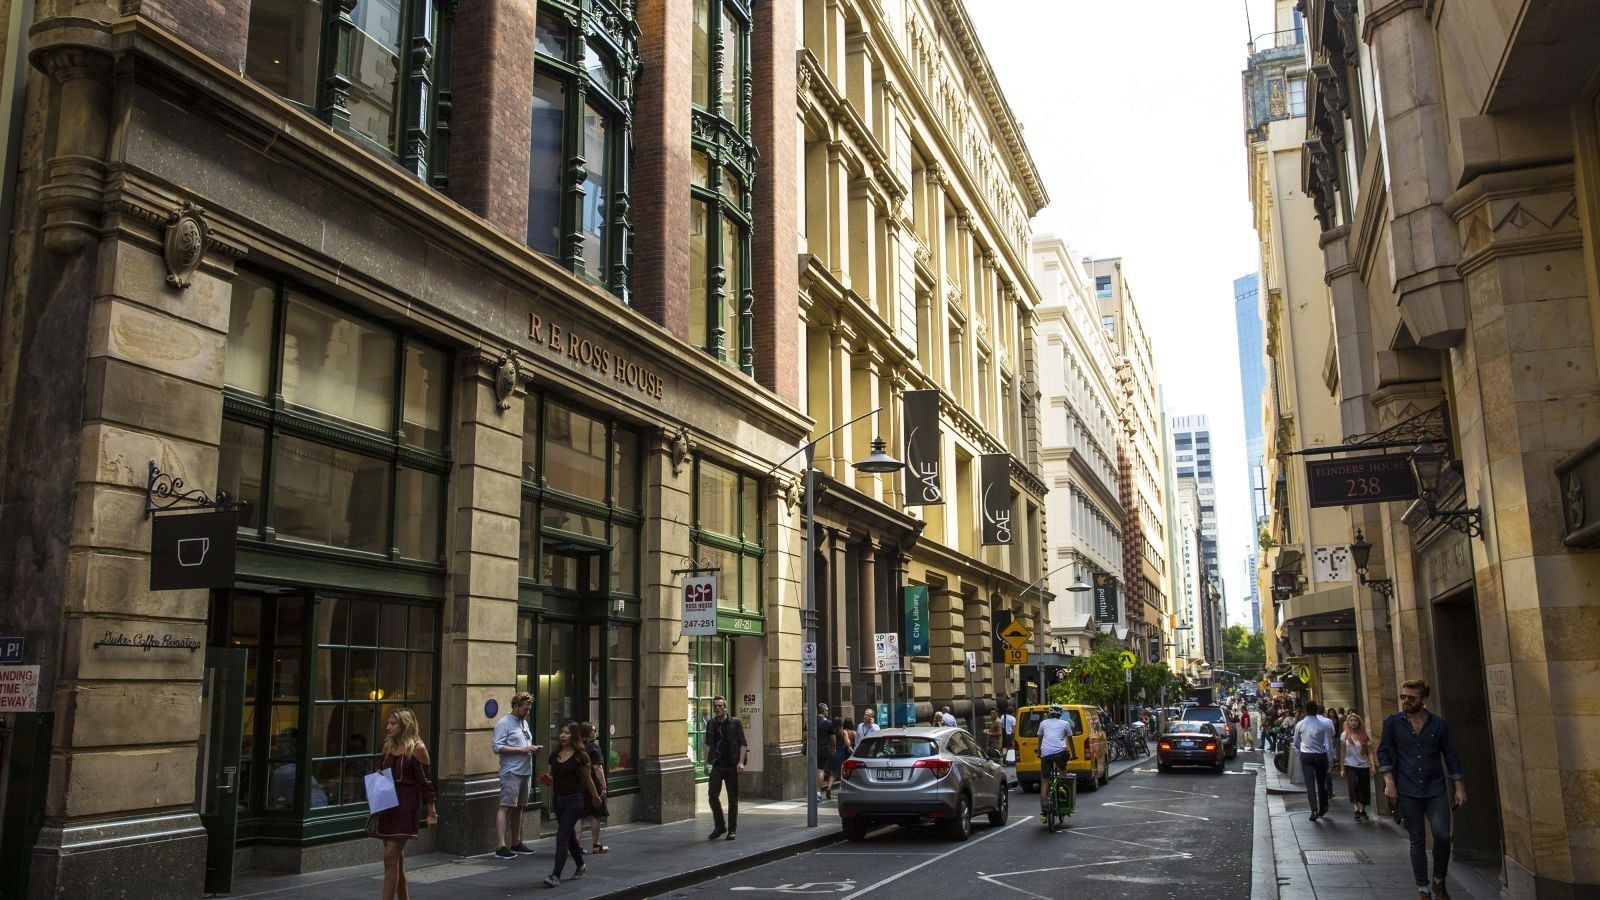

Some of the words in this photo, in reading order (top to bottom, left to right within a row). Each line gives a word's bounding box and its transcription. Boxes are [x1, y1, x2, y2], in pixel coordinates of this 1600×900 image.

[529, 312, 545, 342] R.
[549, 323, 563, 352] E.
[568, 333, 610, 373] ROSS
[614, 356, 664, 399] HOUSE
[920, 461, 940, 502] CAE
[1316, 464, 1365, 477] FLINDERS
[1345, 477, 1380, 497] 238
[995, 509, 1011, 543] CAE
[1183, 526, 1191, 578] VICTORIA
[912, 594, 920, 620] Library
[1097, 588, 1108, 618] punthill
[684, 619, 714, 628] 247-251
[1186, 584, 1195, 649] UNIVERSITY
[875, 634, 885, 642] 2P
[1010, 650, 1022, 659] 10
[0, 696, 28, 707] EWAY
